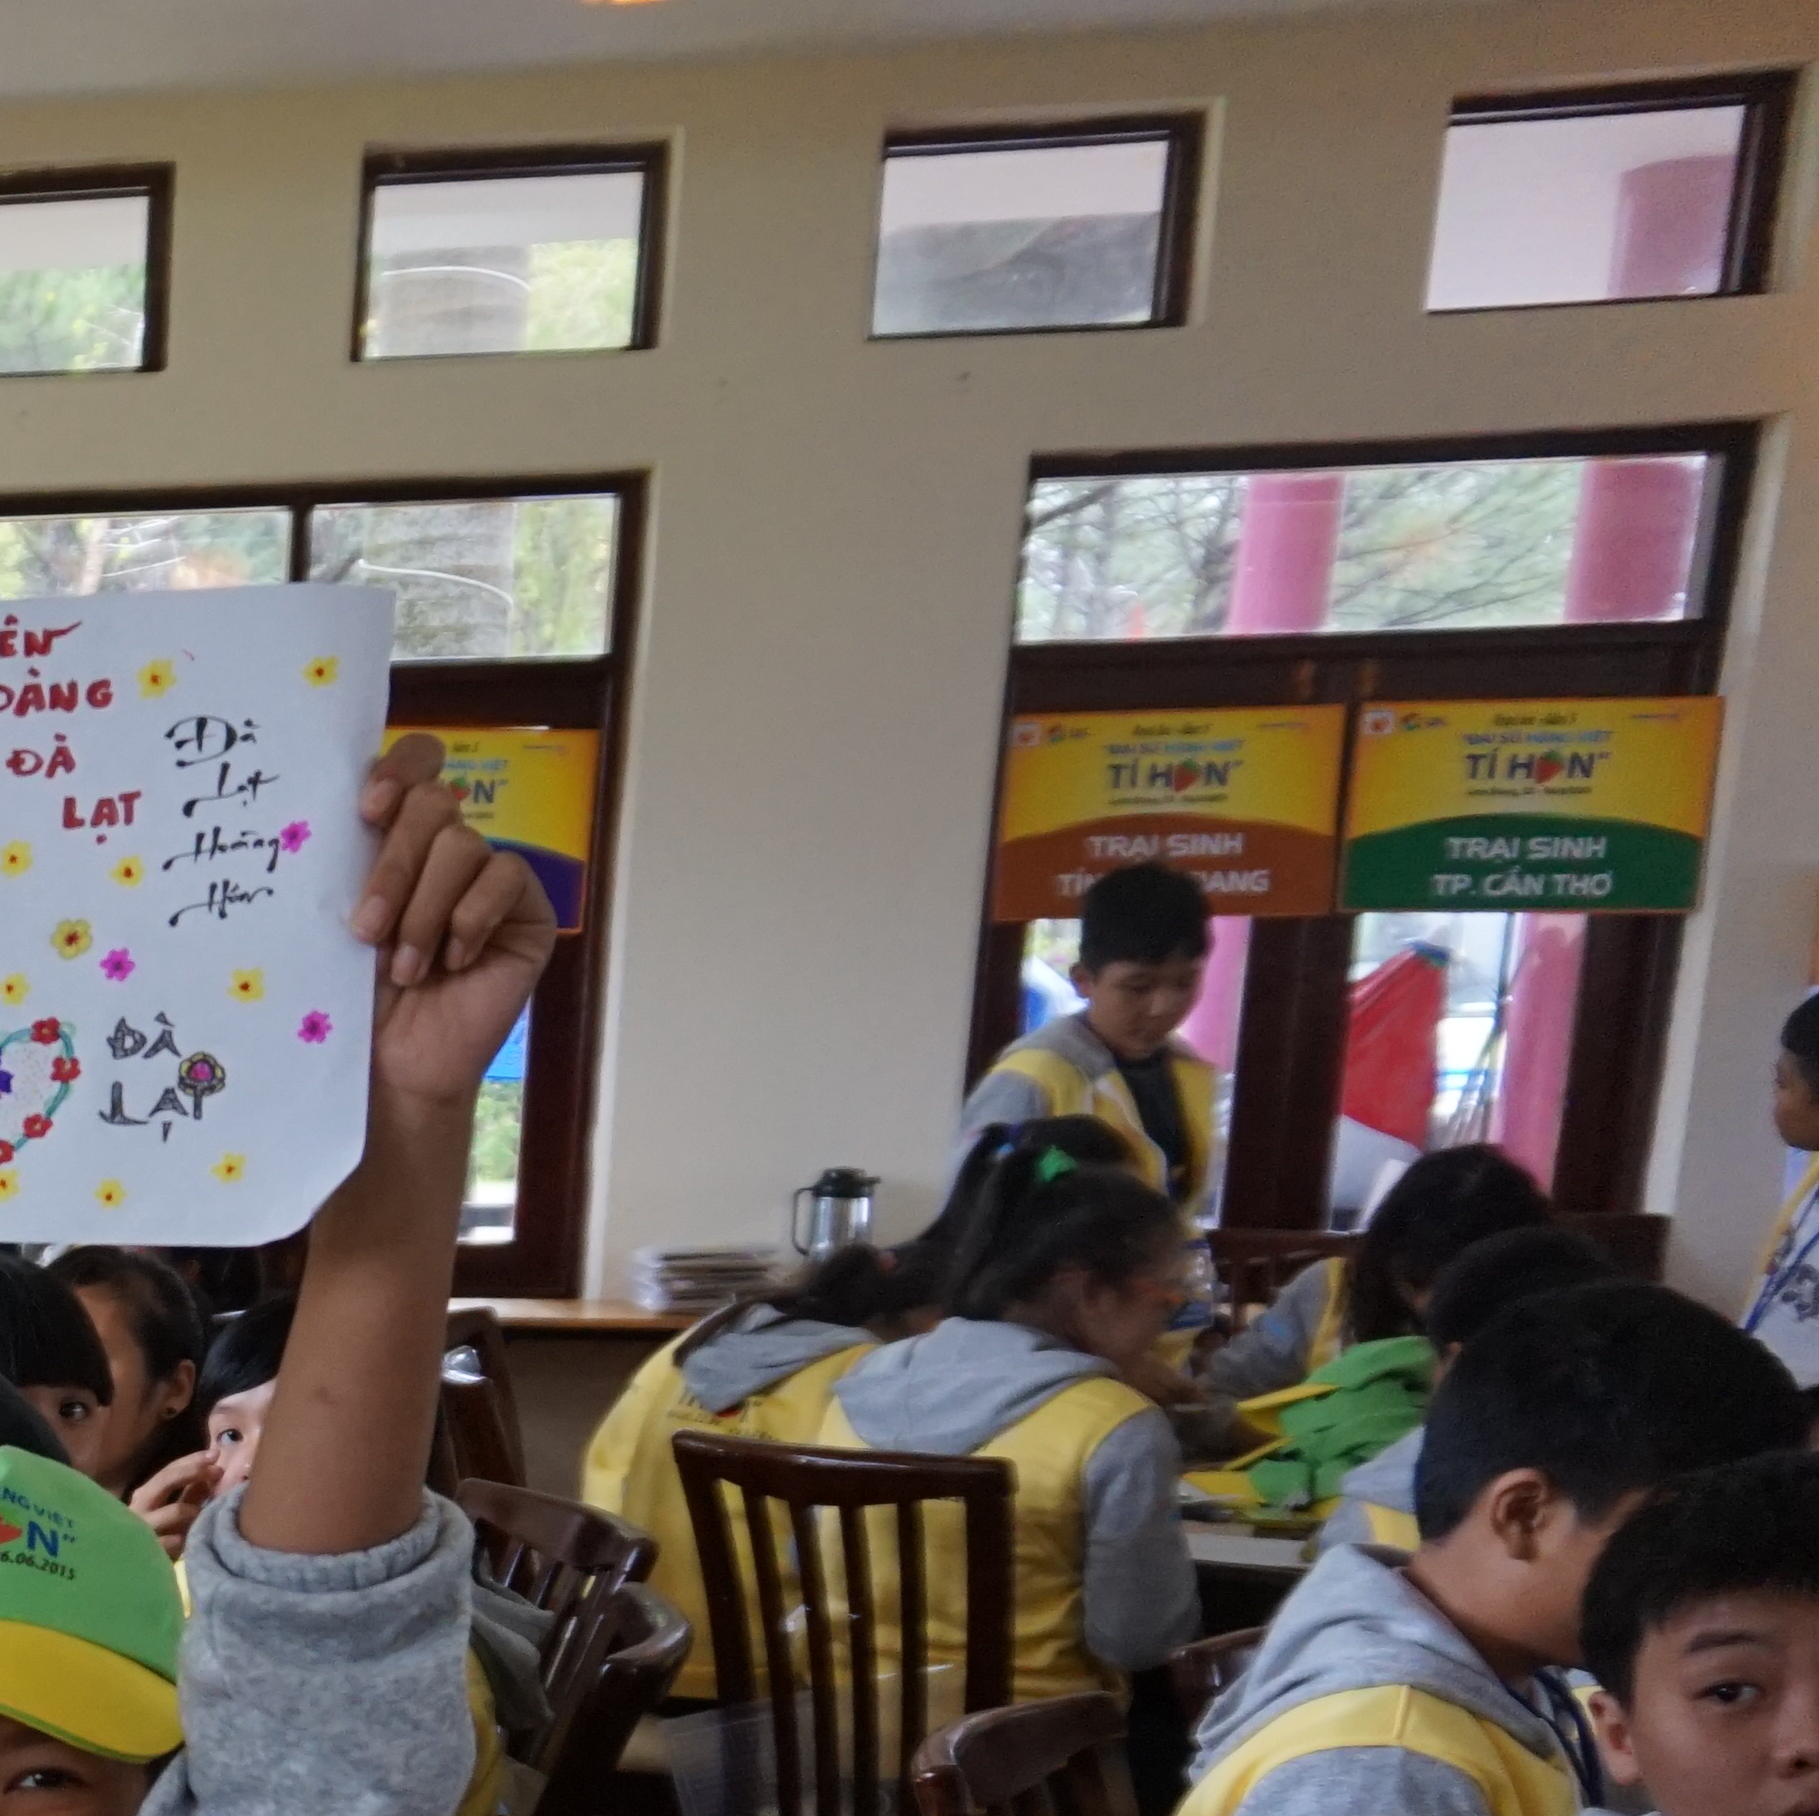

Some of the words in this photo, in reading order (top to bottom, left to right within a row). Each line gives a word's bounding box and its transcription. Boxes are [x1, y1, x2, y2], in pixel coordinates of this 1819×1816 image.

[6, 733, 76, 779] ĐÀ
[63, 790, 142, 845] LẠT
[1166, 831, 1245, 857] SINH
[1444, 836, 1519, 864] TRẠI
[1526, 836, 1609, 861] SINH
[106, 1010, 182, 1060] ĐÀ
